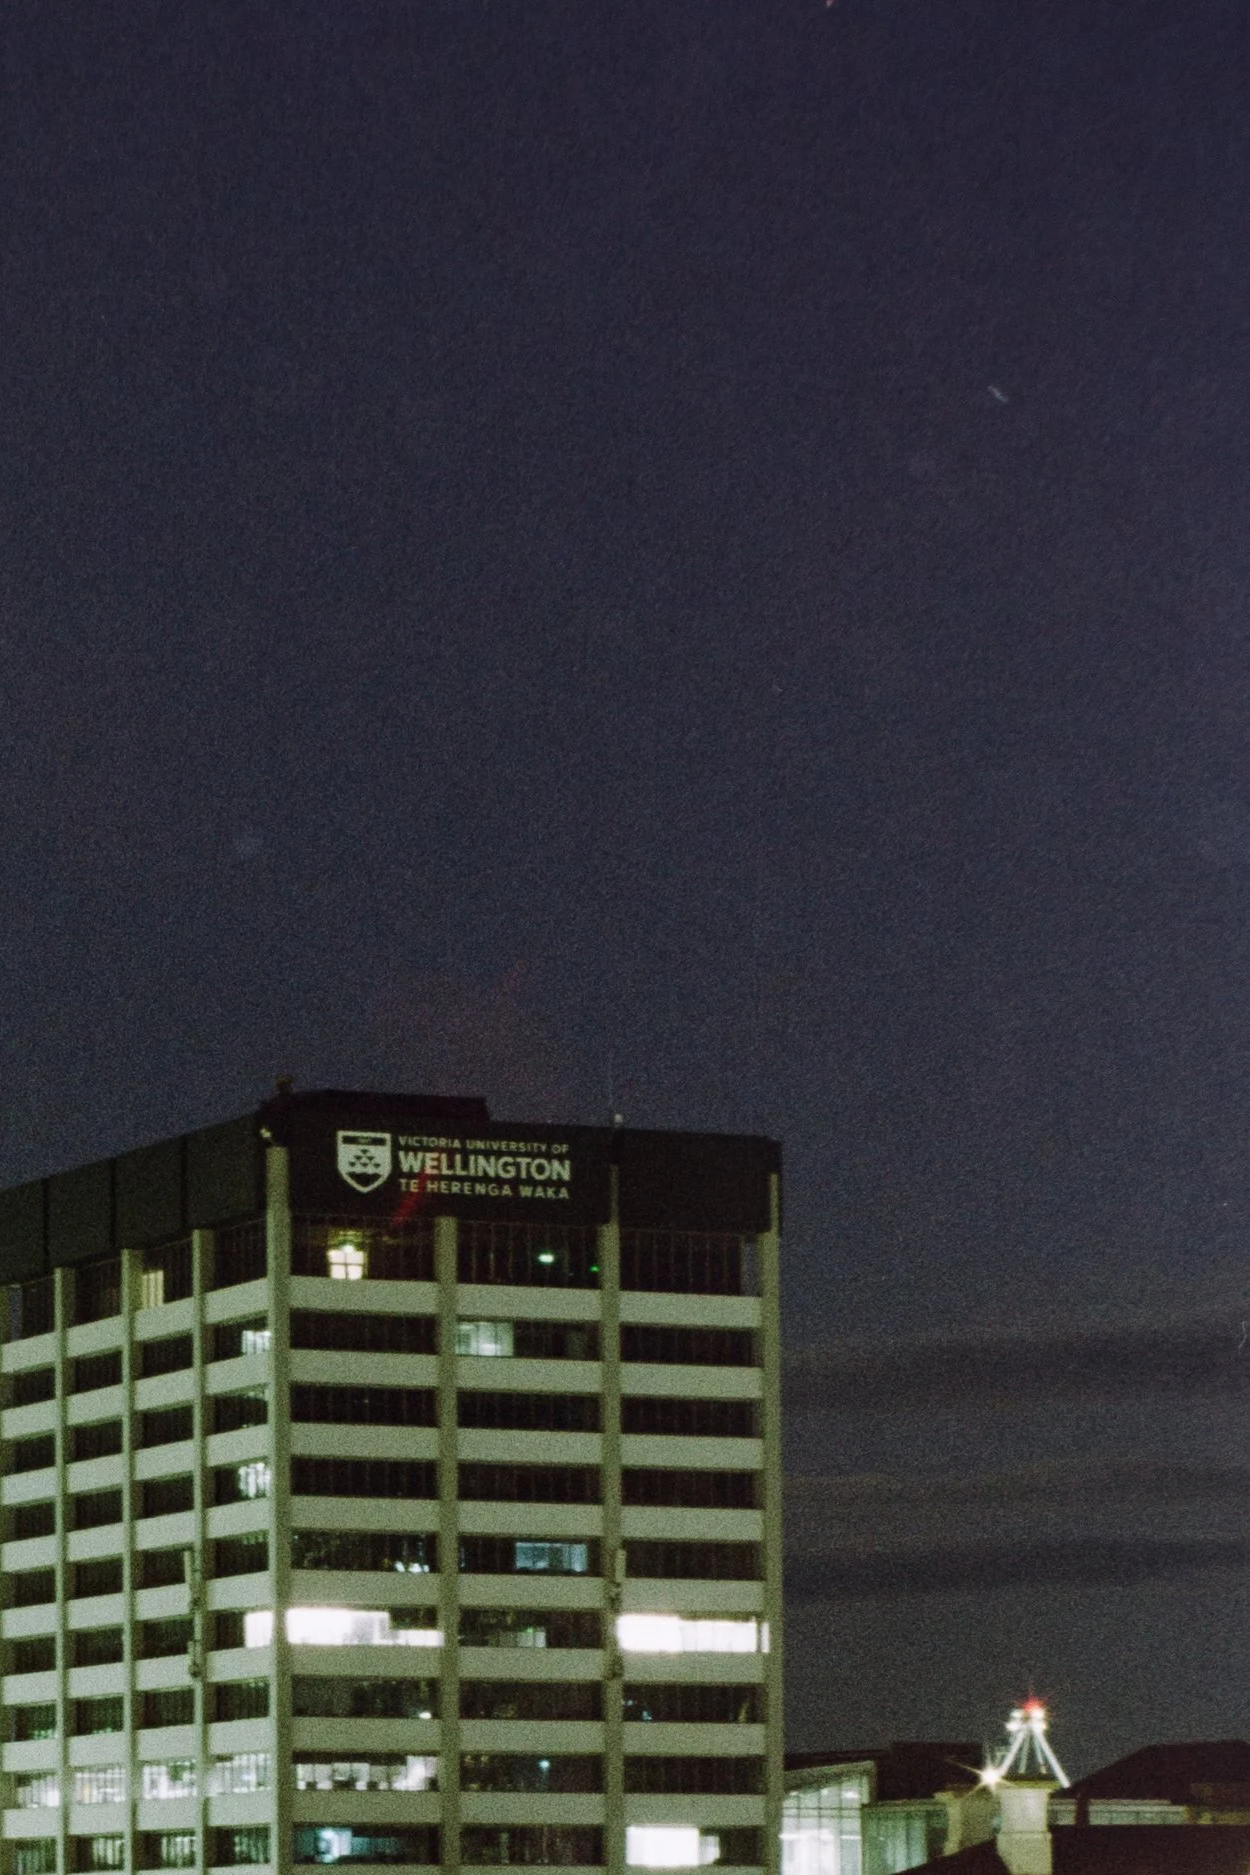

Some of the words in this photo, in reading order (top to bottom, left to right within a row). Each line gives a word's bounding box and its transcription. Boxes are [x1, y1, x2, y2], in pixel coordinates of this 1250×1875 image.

[398, 1135, 461, 1149] VICTORIA
[466, 1139, 547, 1153] UNIVERSITY
[552, 1143, 569, 1154] OF
[398, 1150, 571, 1181] WELLINGTON
[399, 1178, 419, 1192] TE
[425, 1180, 512, 1197] HERENGA
[519, 1185, 569, 1199] WAKA
